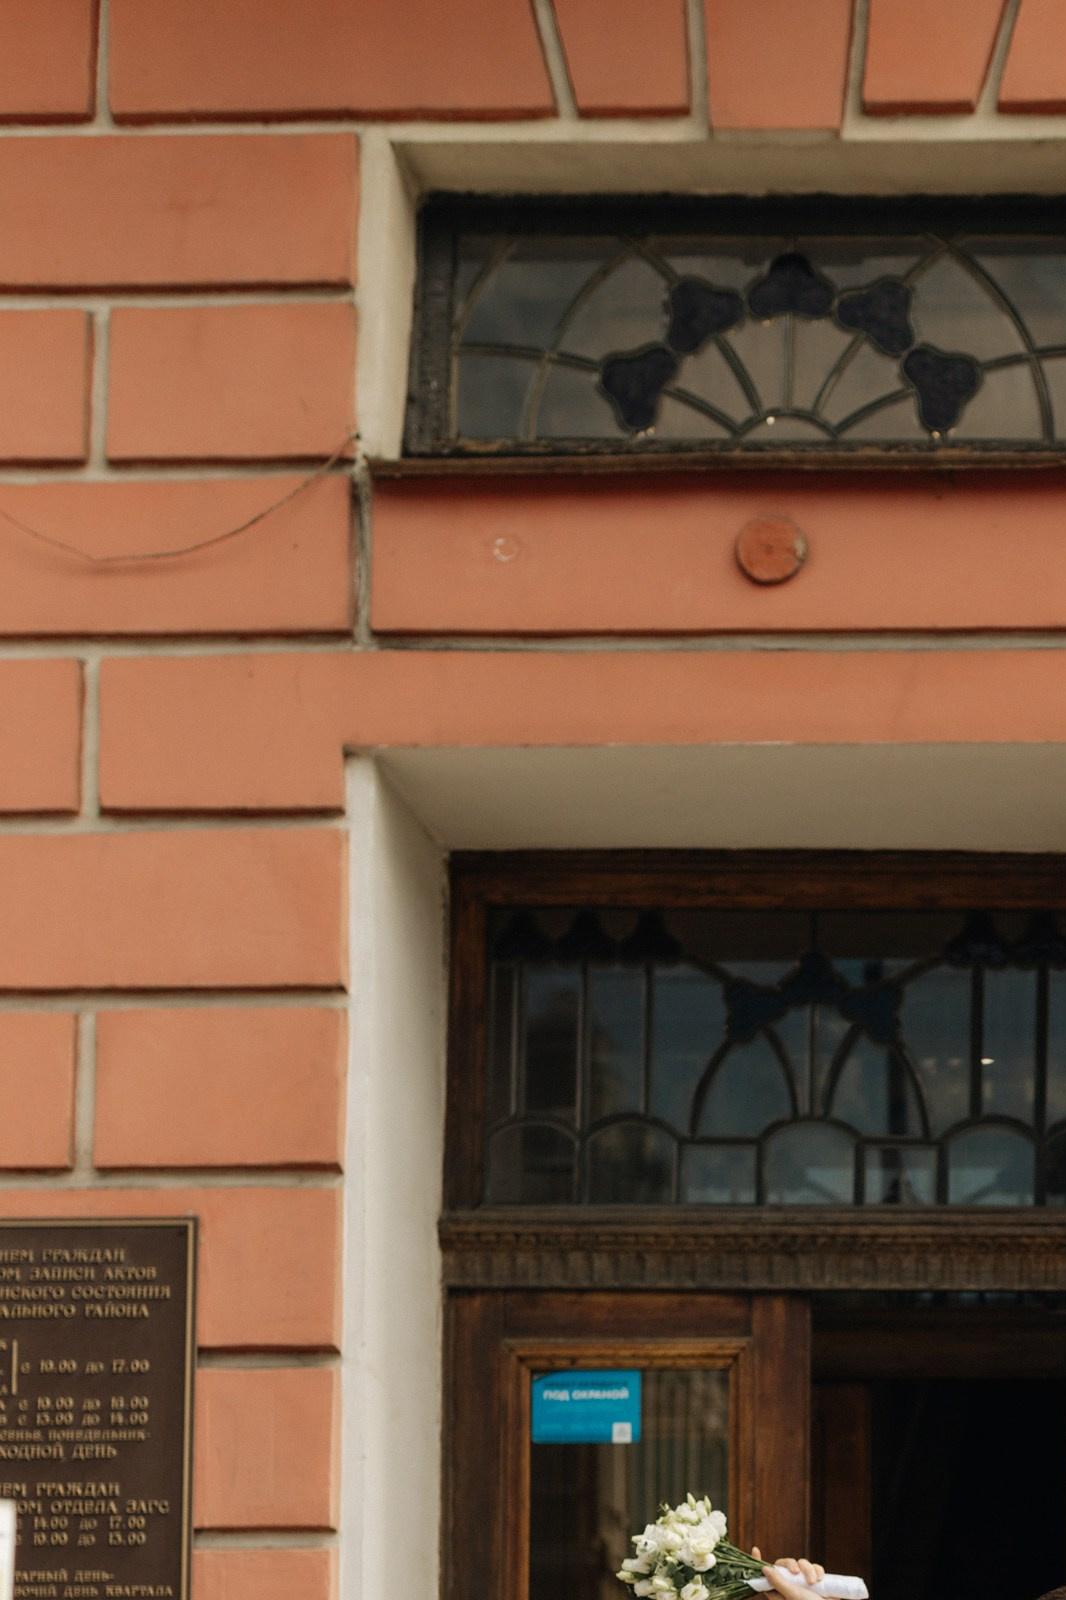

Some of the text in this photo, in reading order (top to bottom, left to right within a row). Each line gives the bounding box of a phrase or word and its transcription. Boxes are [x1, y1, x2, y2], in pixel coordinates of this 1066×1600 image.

[29, 1266, 96, 1281] ЗАПИСИ
[103, 1266, 157, 1281] АКТОВ
[71, 1284, 171, 1300] СОСТОЯНИЯ
[84, 1301, 150, 1318] РАЙОНА
[39, 1358, 78, 1374] 10.00
[112, 1358, 150, 1374] 17.00
[37, 1396, 75, 1411] 10.00
[71, 1444, 118, 1461] ДЕНЬ
[36, 1482, 121, 1498] ГРАЖДАН
[50, 1500, 119, 1516] ОТДЕЛА
[125, 1500, 170, 1515] ЗАГС
[109, 1515, 146, 1530] 17.00
[33, 1531, 69, 1546] 10.00
[63, 1585, 99, 1599] ДЕНЬ
[105, 1585, 174, 1598] КВАРТАЛА
